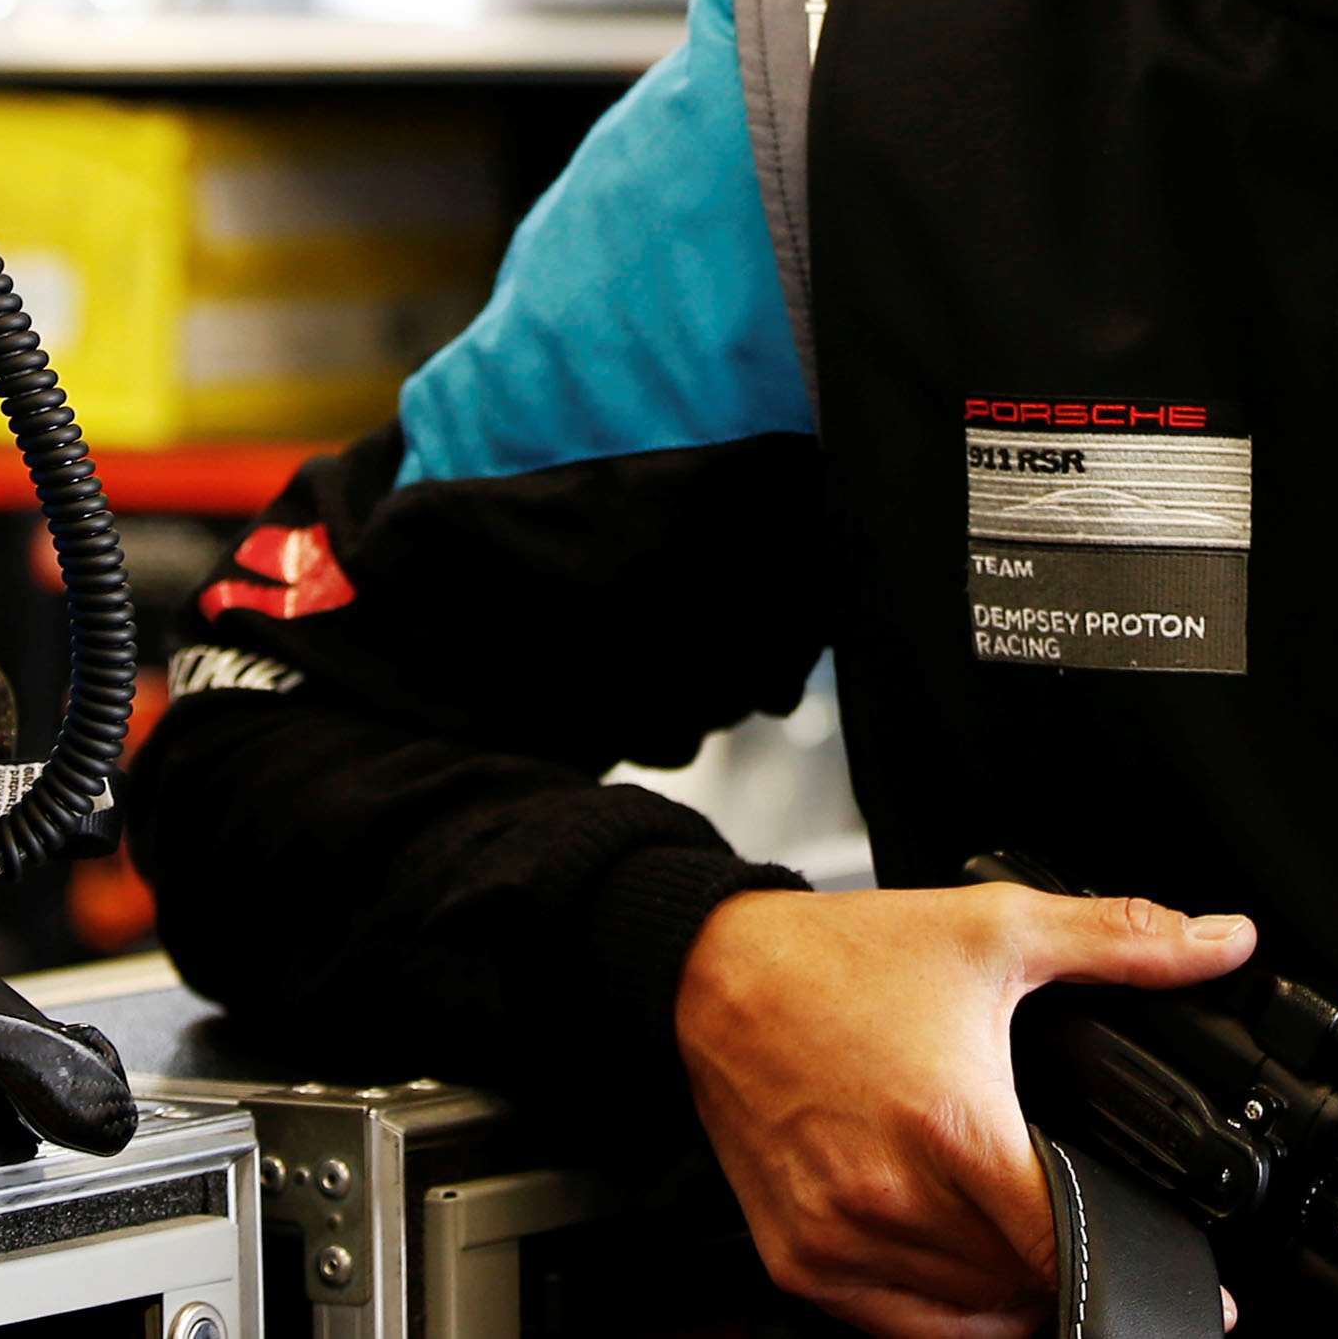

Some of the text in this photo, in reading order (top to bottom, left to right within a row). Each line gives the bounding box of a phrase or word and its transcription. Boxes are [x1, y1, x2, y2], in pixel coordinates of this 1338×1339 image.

[964, 398, 1208, 428] PORSCHE
[968, 446, 1086, 474] 911 RSR
[970, 555, 1034, 578] TEAM
[973, 604, 1206, 640] DEMPSEY PROTON
[975, 631, 1061, 660] RACING
